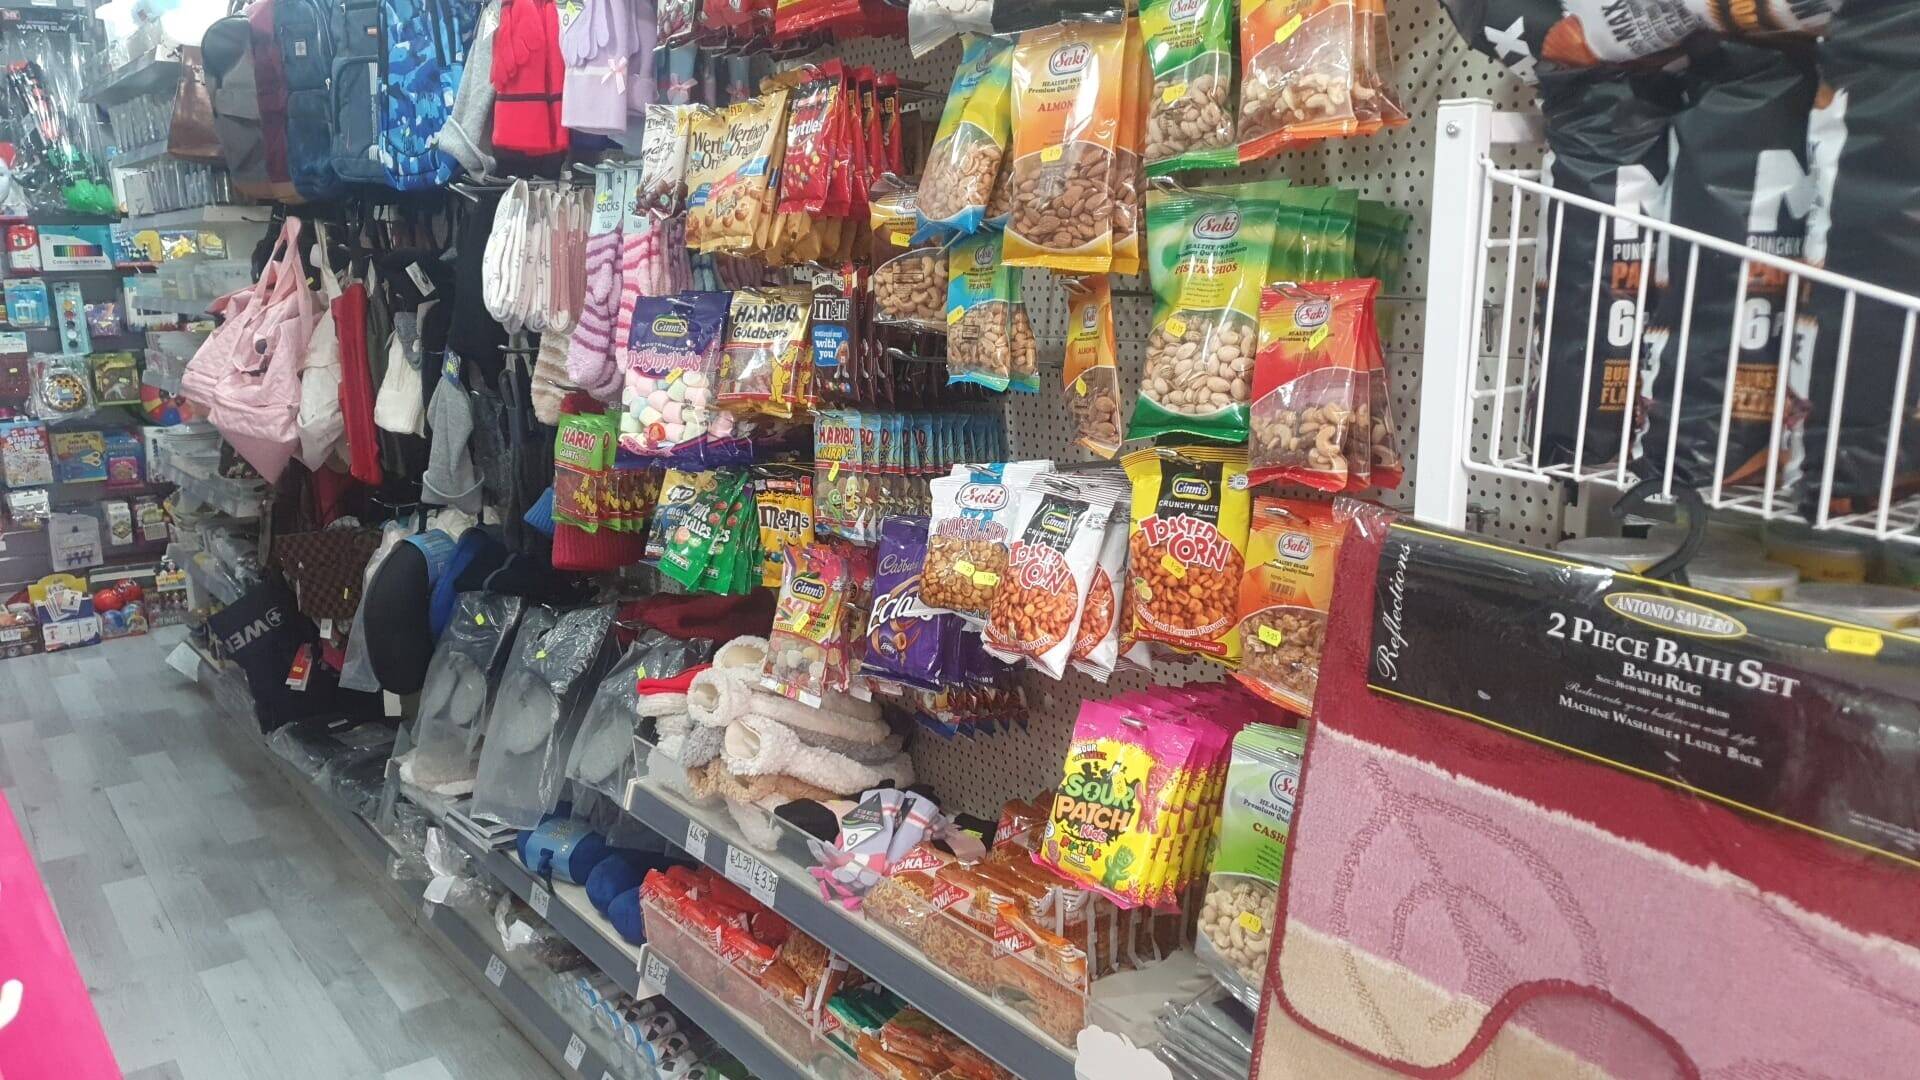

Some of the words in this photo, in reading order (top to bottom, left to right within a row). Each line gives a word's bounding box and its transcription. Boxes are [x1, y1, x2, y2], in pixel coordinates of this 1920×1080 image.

[1054, 49, 1086, 67] Saki
[1037, 100, 1073, 112] ALMON
[596, 202, 620, 213] SOCKS
[1200, 217, 1238, 232] Saki
[734, 304, 799, 323] HARIBO
[1300, 305, 1327, 320] Saki
[733, 326, 788, 339] Goldbears
[815, 338, 837, 348] with
[818, 349, 834, 360] you
[819, 426, 855, 445] HARIBO
[671, 488, 694, 499] KP
[963, 487, 1004, 504] Saki
[1174, 482, 1208, 496] Ginni's
[1158, 500, 1196, 509] CRUNCHY
[1197, 504, 1219, 512] NUTS
[1138, 512, 1217, 547] TOASTED
[1167, 531, 1231, 572] CORN
[1284, 534, 1311, 554] Saki
[1020, 557, 1072, 596] CORN
[793, 580, 824, 599] Ginni's
[1376, 543, 1411, 681] Reflections
[1614, 595, 1675, 621] ANTONIO
[1153, 620, 1169, 632] and
[1198, 616, 1228, 635] Flavour
[1546, 612, 1566, 638] 2
[1571, 615, 1649, 660] PIECE
[1652, 637, 1733, 682] BATH
[1736, 659, 1801, 698] SET
[1622, 662, 1663, 687] BATH
[1664, 673, 1702, 697] RUG
[1065, 773, 1135, 810] SOUR
[1277, 777, 1297, 797] Sa
[1056, 795, 1132, 832] PATCH
[1243, 799, 1275, 818] Premium
[1080, 824, 1109, 844] Kids
[755, 866, 777, 892] £3.99
